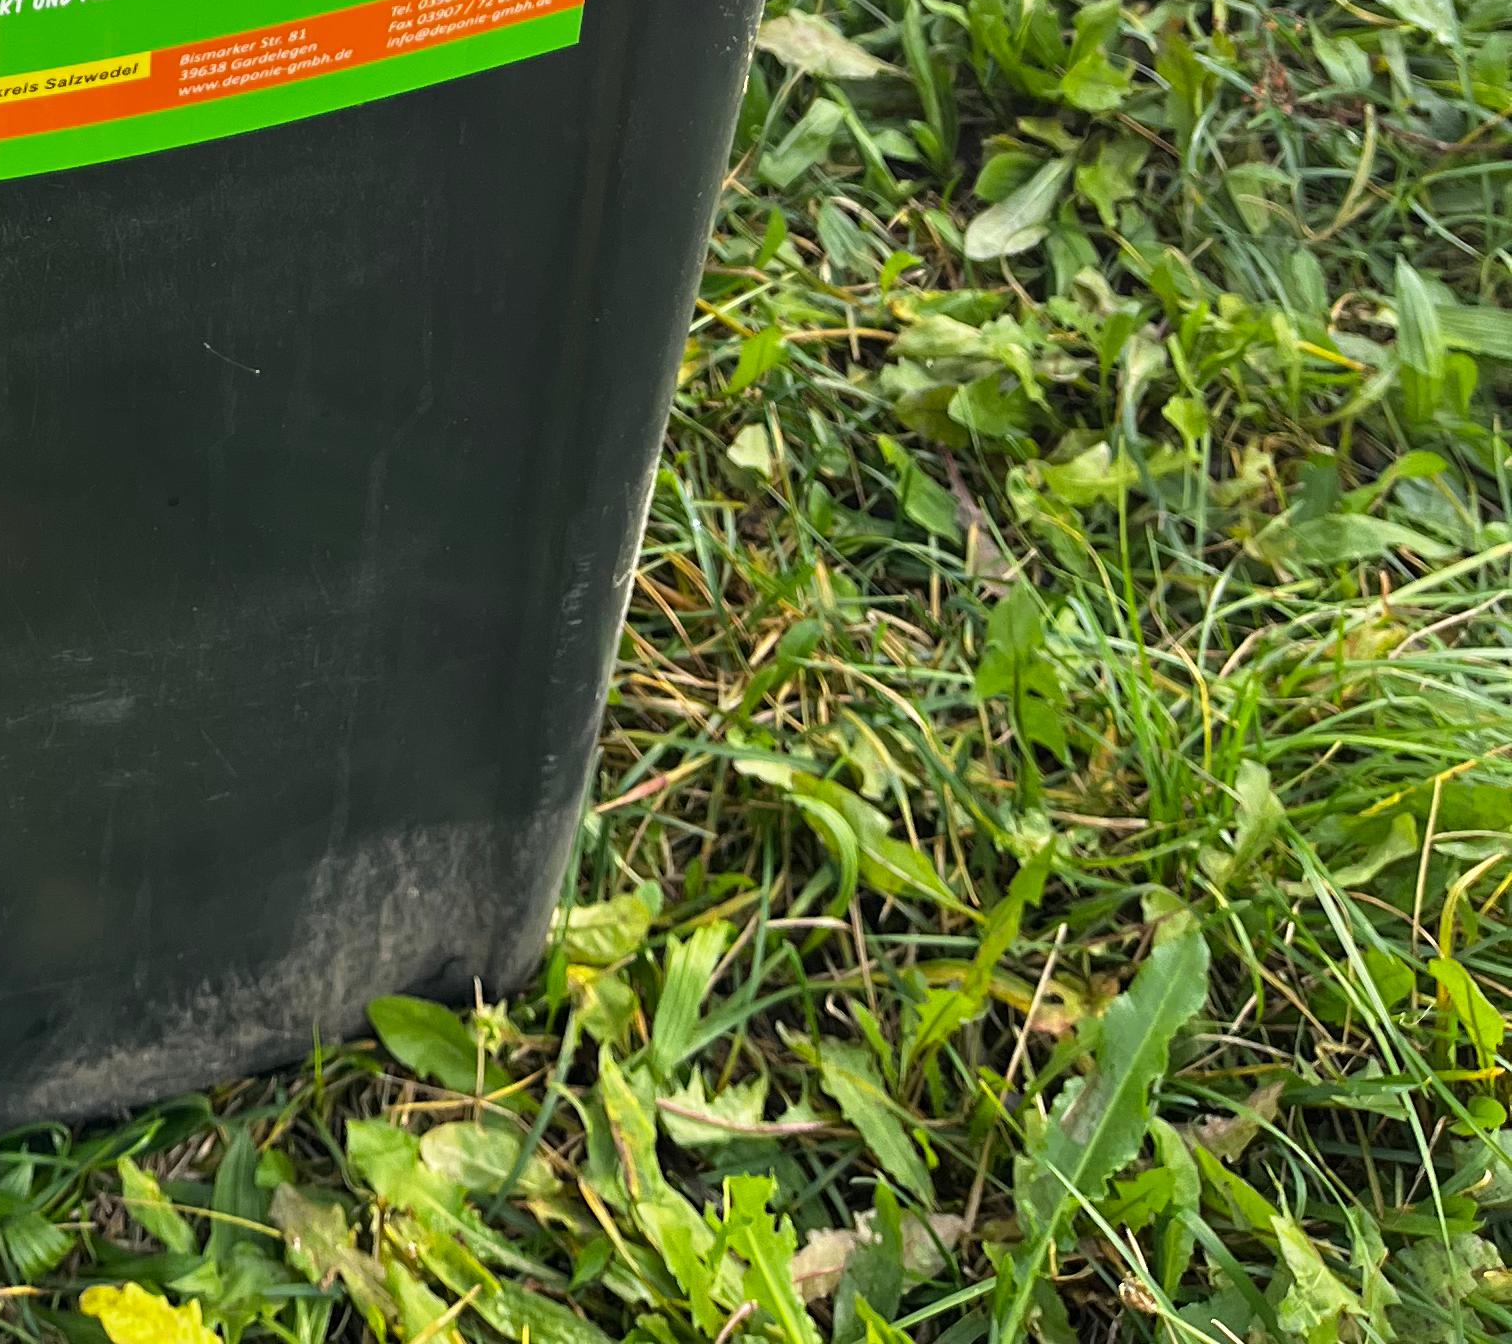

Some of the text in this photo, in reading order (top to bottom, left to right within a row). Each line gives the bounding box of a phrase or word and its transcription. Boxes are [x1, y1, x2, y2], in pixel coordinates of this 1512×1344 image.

[388, 20, 413, 33] Fax
[416, 4, 462, 26] 03907
[391, 2, 413, 17] Tel.
[179, 28, 307, 66] Bismarker Str. 81
[179, 42, 318, 81] 39638 Gardelegen
[44, 62, 139, 90] Salzwedel
[178, 48, 354, 97] www.deponie-gmbh.de
